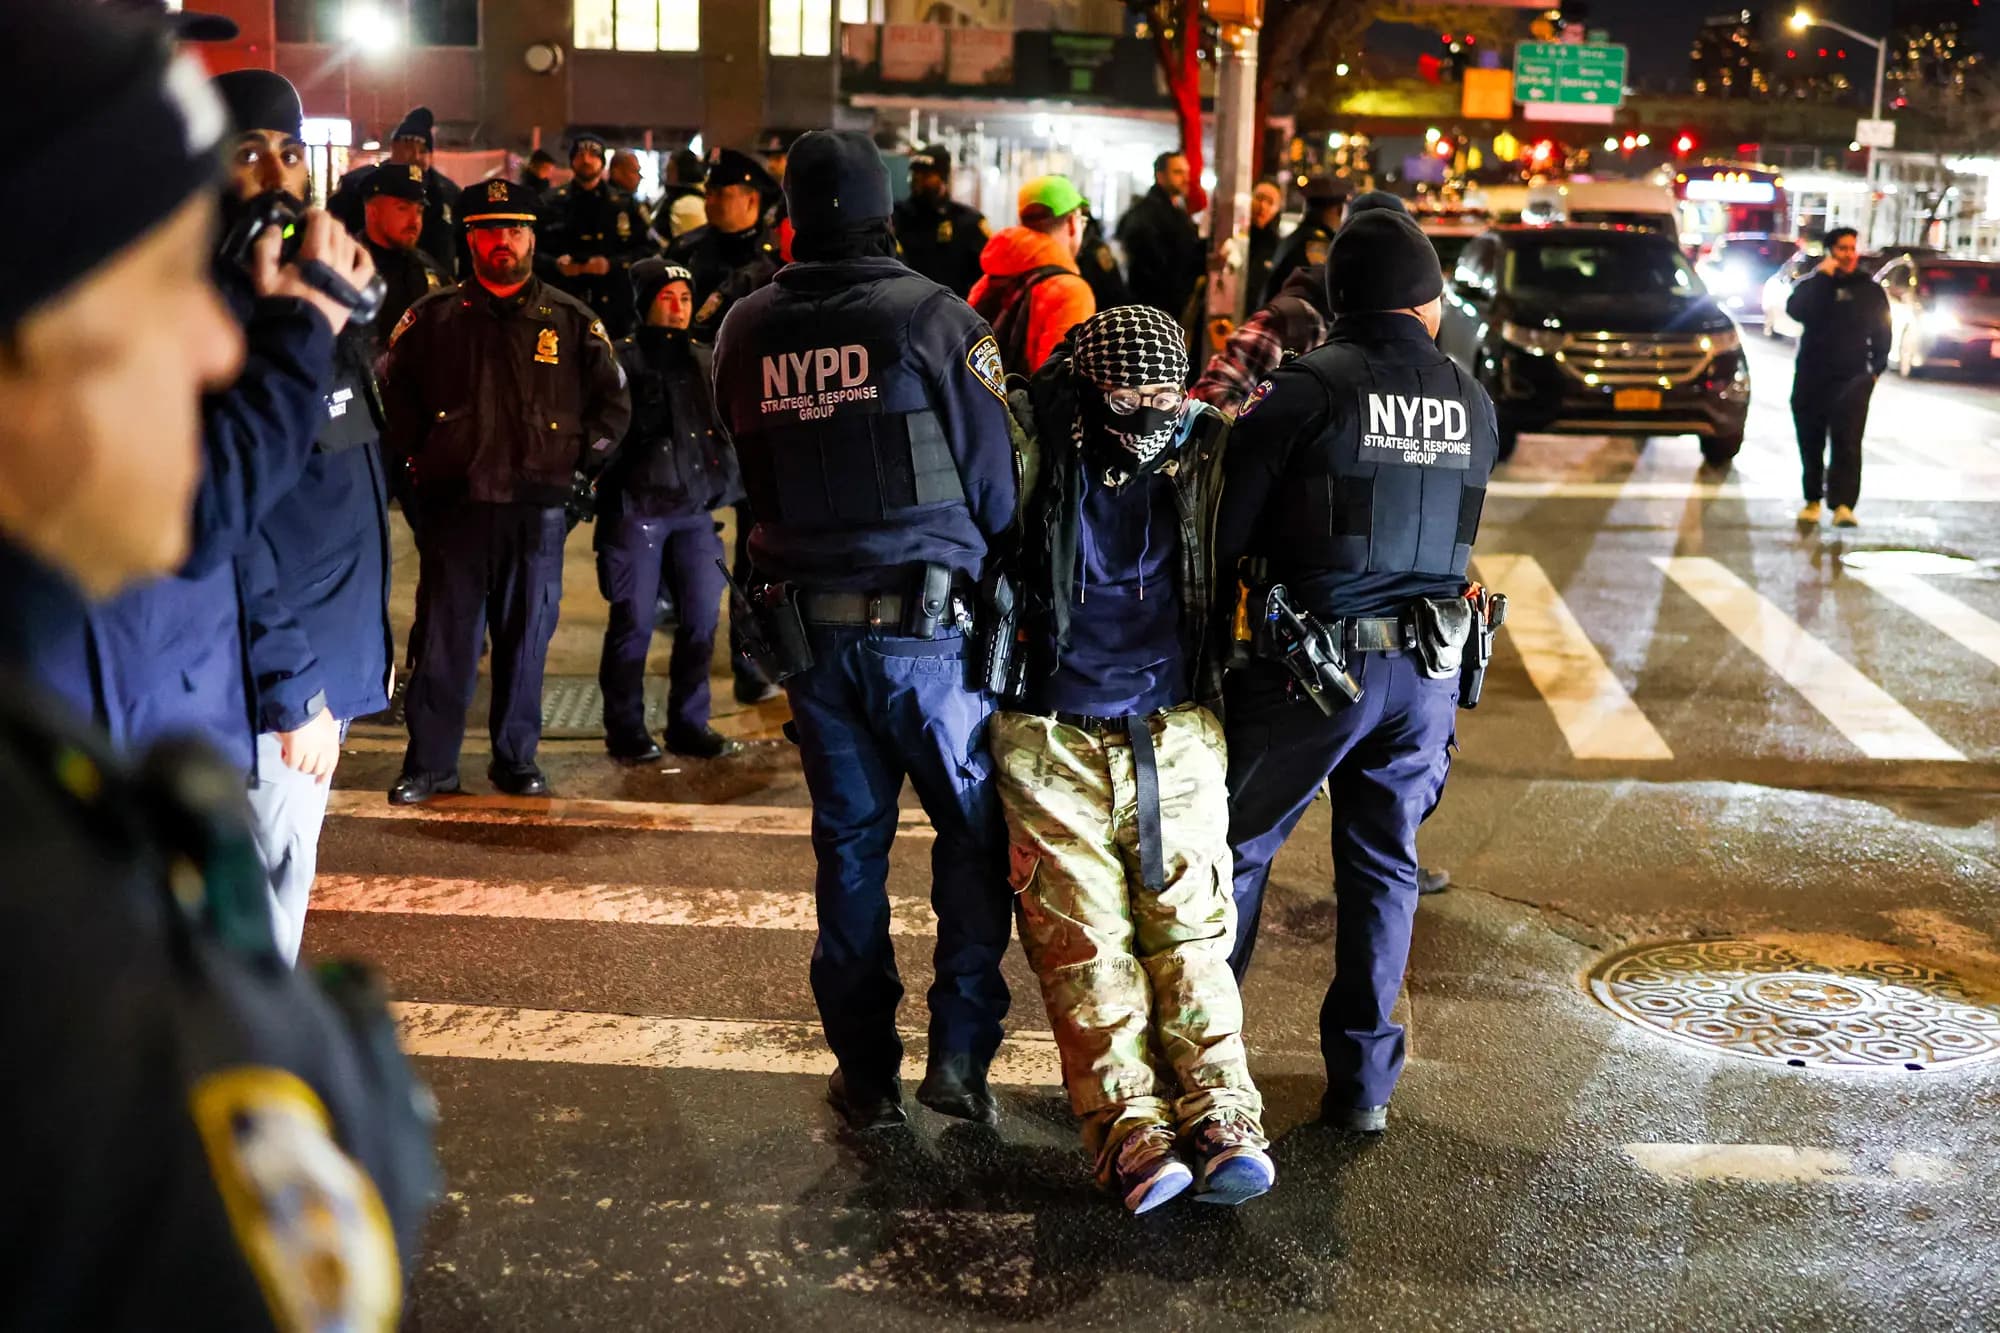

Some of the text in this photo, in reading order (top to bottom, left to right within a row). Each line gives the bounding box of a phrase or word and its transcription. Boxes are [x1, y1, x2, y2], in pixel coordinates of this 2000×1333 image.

[763, 344, 869, 398] NYPD
[760, 386, 878, 414] STRATEGIC RESPONSE
[799, 404, 835, 421] GROUP
[1368, 393, 1467, 441] NYPD
[1363, 434, 1471, 455] STRATEGIC RESPONSE
[1403, 450, 1437, 465] GROUP
